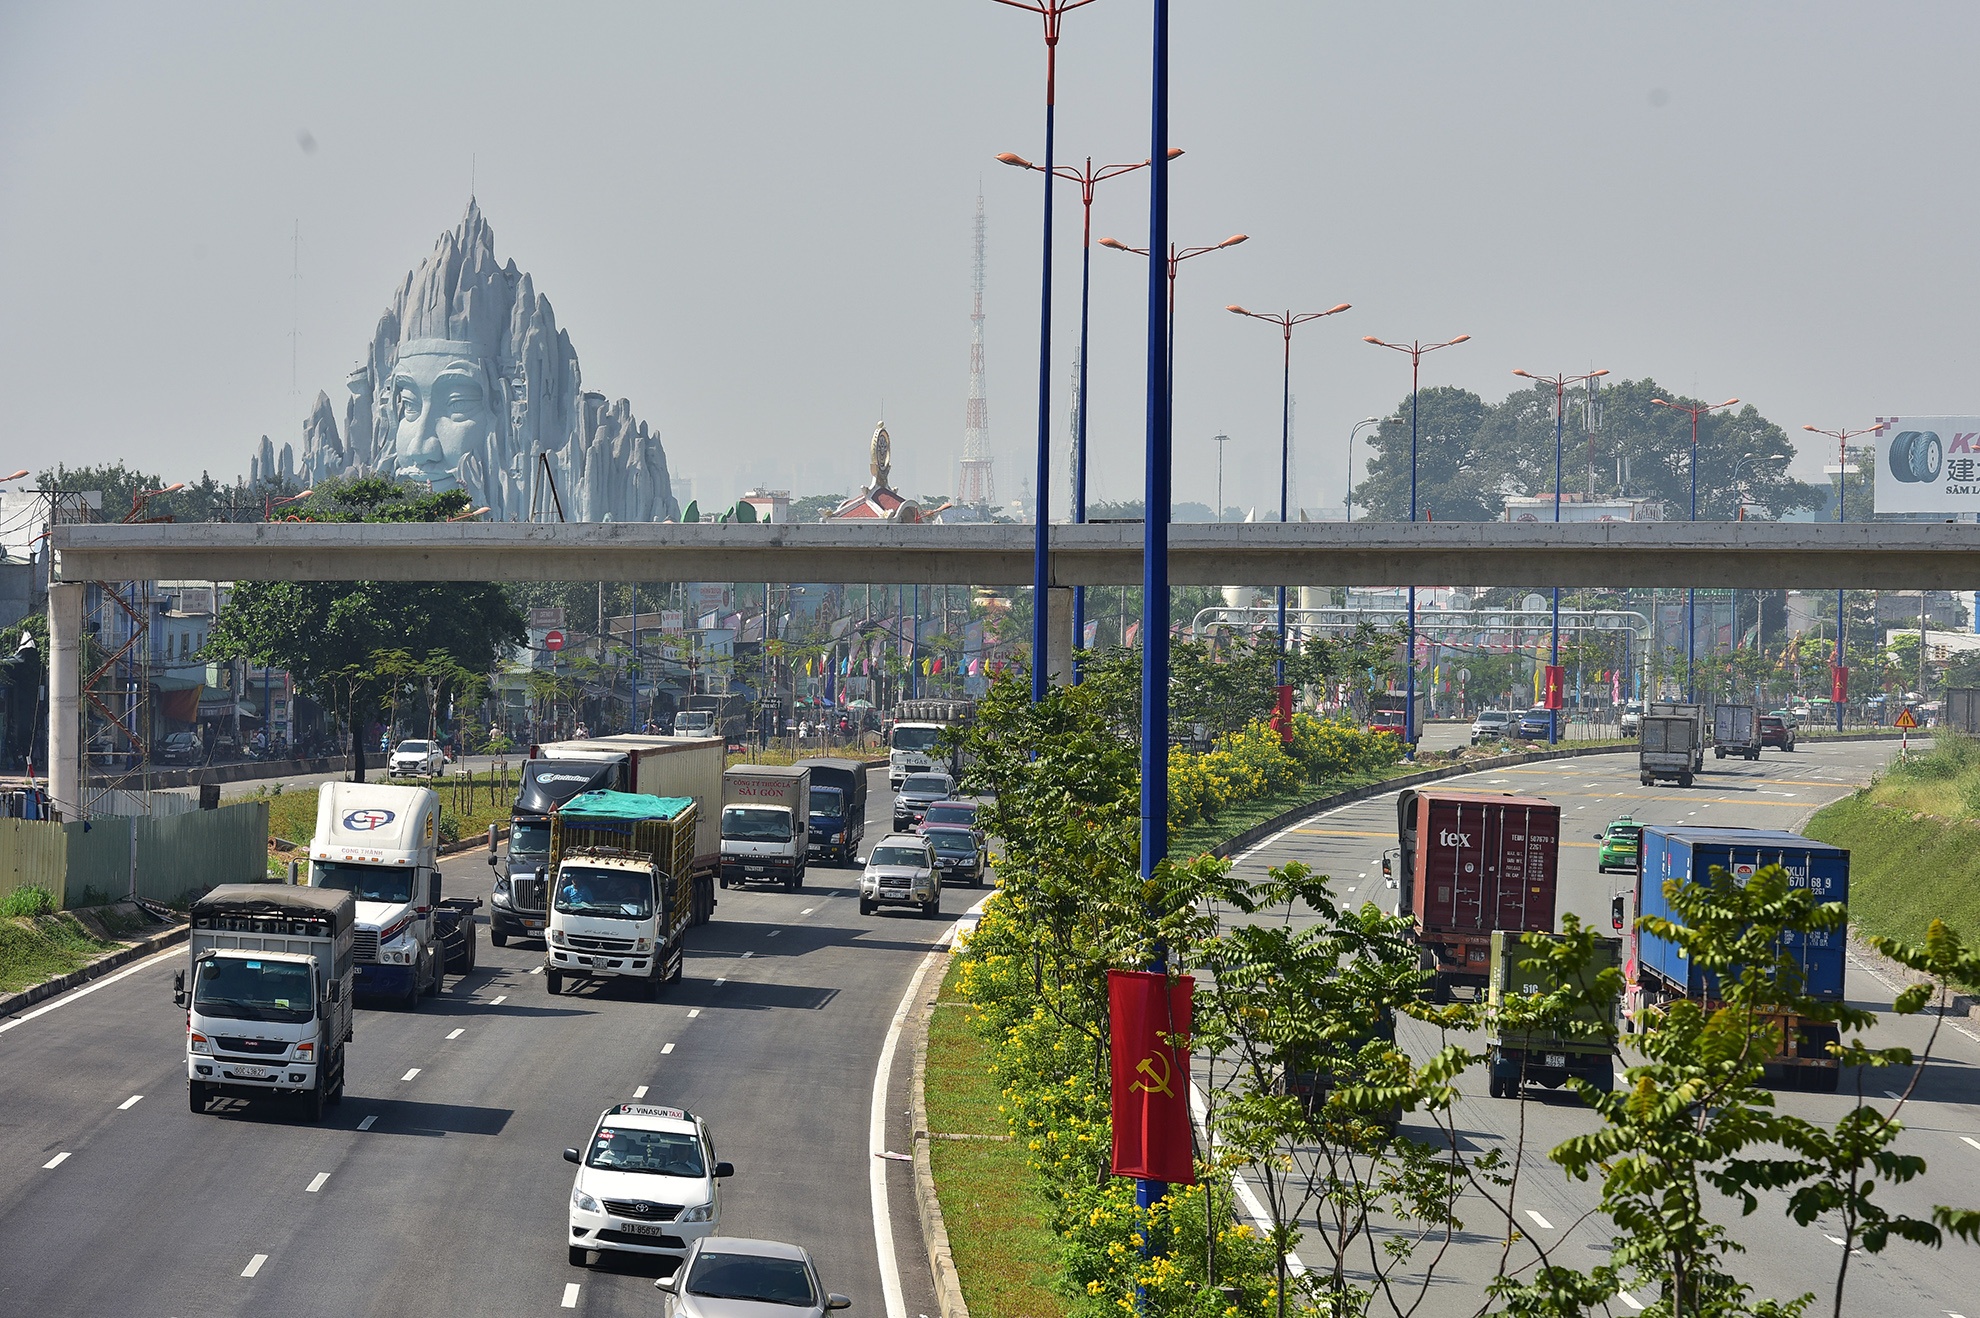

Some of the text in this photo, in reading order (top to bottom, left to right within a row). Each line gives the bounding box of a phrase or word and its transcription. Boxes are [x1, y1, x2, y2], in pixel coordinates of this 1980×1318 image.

[1945, 484, 1970, 495] SĂM
[738, 786, 784, 797] SÀI GÒN
[1440, 828, 1471, 848] tex
[1787, 876, 1805, 887] 670
[1825, 878, 1831, 888] 9
[1523, 984, 1539, 994] 51C
[636, 1107, 683, 1119] VINASUN TAXI
